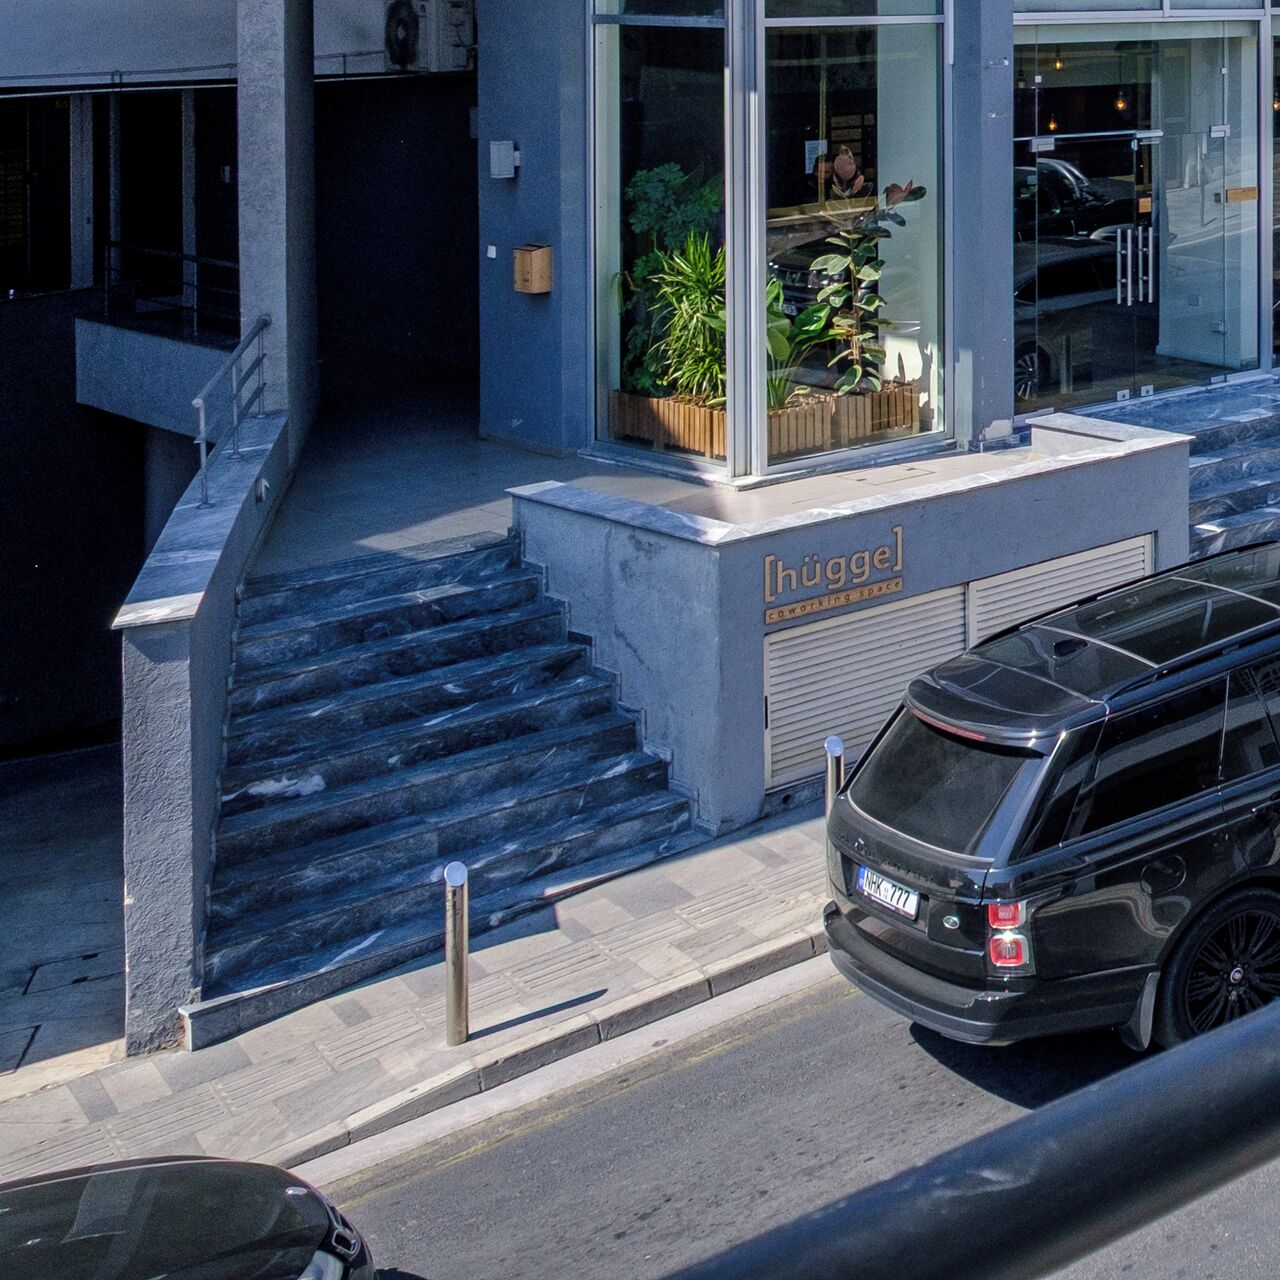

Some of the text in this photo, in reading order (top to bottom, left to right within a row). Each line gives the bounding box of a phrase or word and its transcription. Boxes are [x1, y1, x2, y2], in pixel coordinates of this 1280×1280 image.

[768, 580, 900, 620] coworking space
[864, 869, 883, 898] NHK
[890, 883, 911, 909] 777
